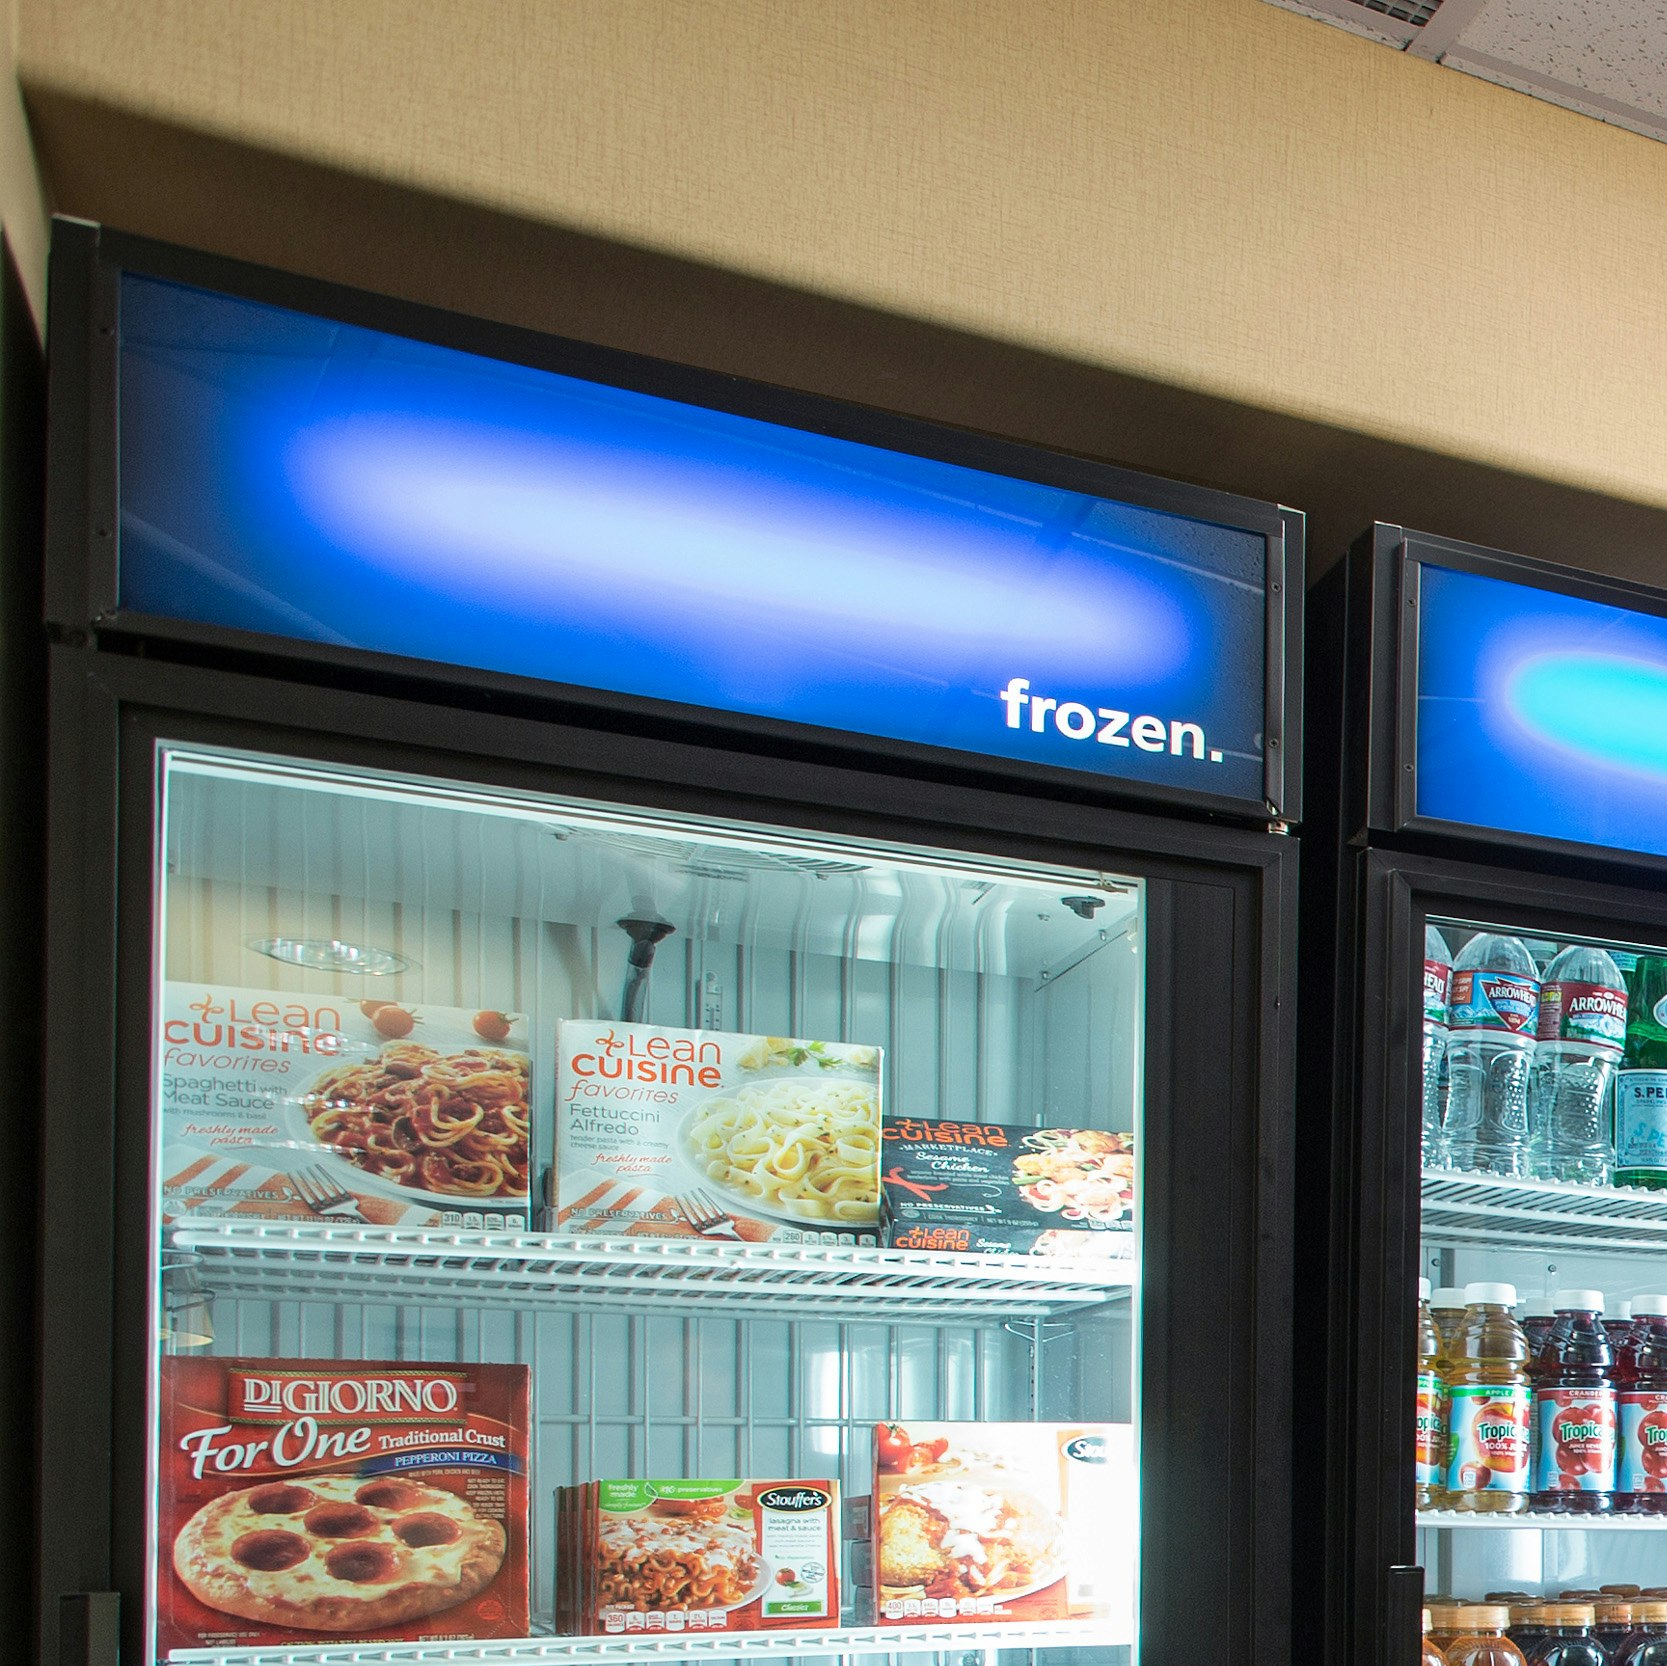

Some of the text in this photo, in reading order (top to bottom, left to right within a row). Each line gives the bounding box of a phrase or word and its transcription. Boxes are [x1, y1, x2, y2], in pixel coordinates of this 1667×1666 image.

[1000, 677, 1223, 763] frozen.
[229, 998, 341, 1031] Lean
[628, 1034, 721, 1065] Lean
[163, 1073, 257, 1094] Spaghetti
[565, 1079, 679, 1104] favorites
[215, 1093, 274, 1110] Sauce
[570, 1103, 660, 1123] Fettuccini
[238, 1125, 279, 1135] made
[570, 1118, 639, 1136] Alfredo
[923, 1121, 1004, 1138] Lean
[210, 1135, 253, 1146] pasta
[639, 1154, 673, 1164] made
[915, 1151, 971, 1163] Sesame
[616, 1163, 653, 1174] pasta
[931, 1160, 990, 1174] Chicken
[924, 1227, 970, 1240] Lean
[179, 1416, 372, 1480] For One
[378, 1428, 506, 1451] Traditional Crust
[394, 1451, 497, 1468] PEPPERONI PIZZA
[765, 1490, 823, 1508] Stouffer's
